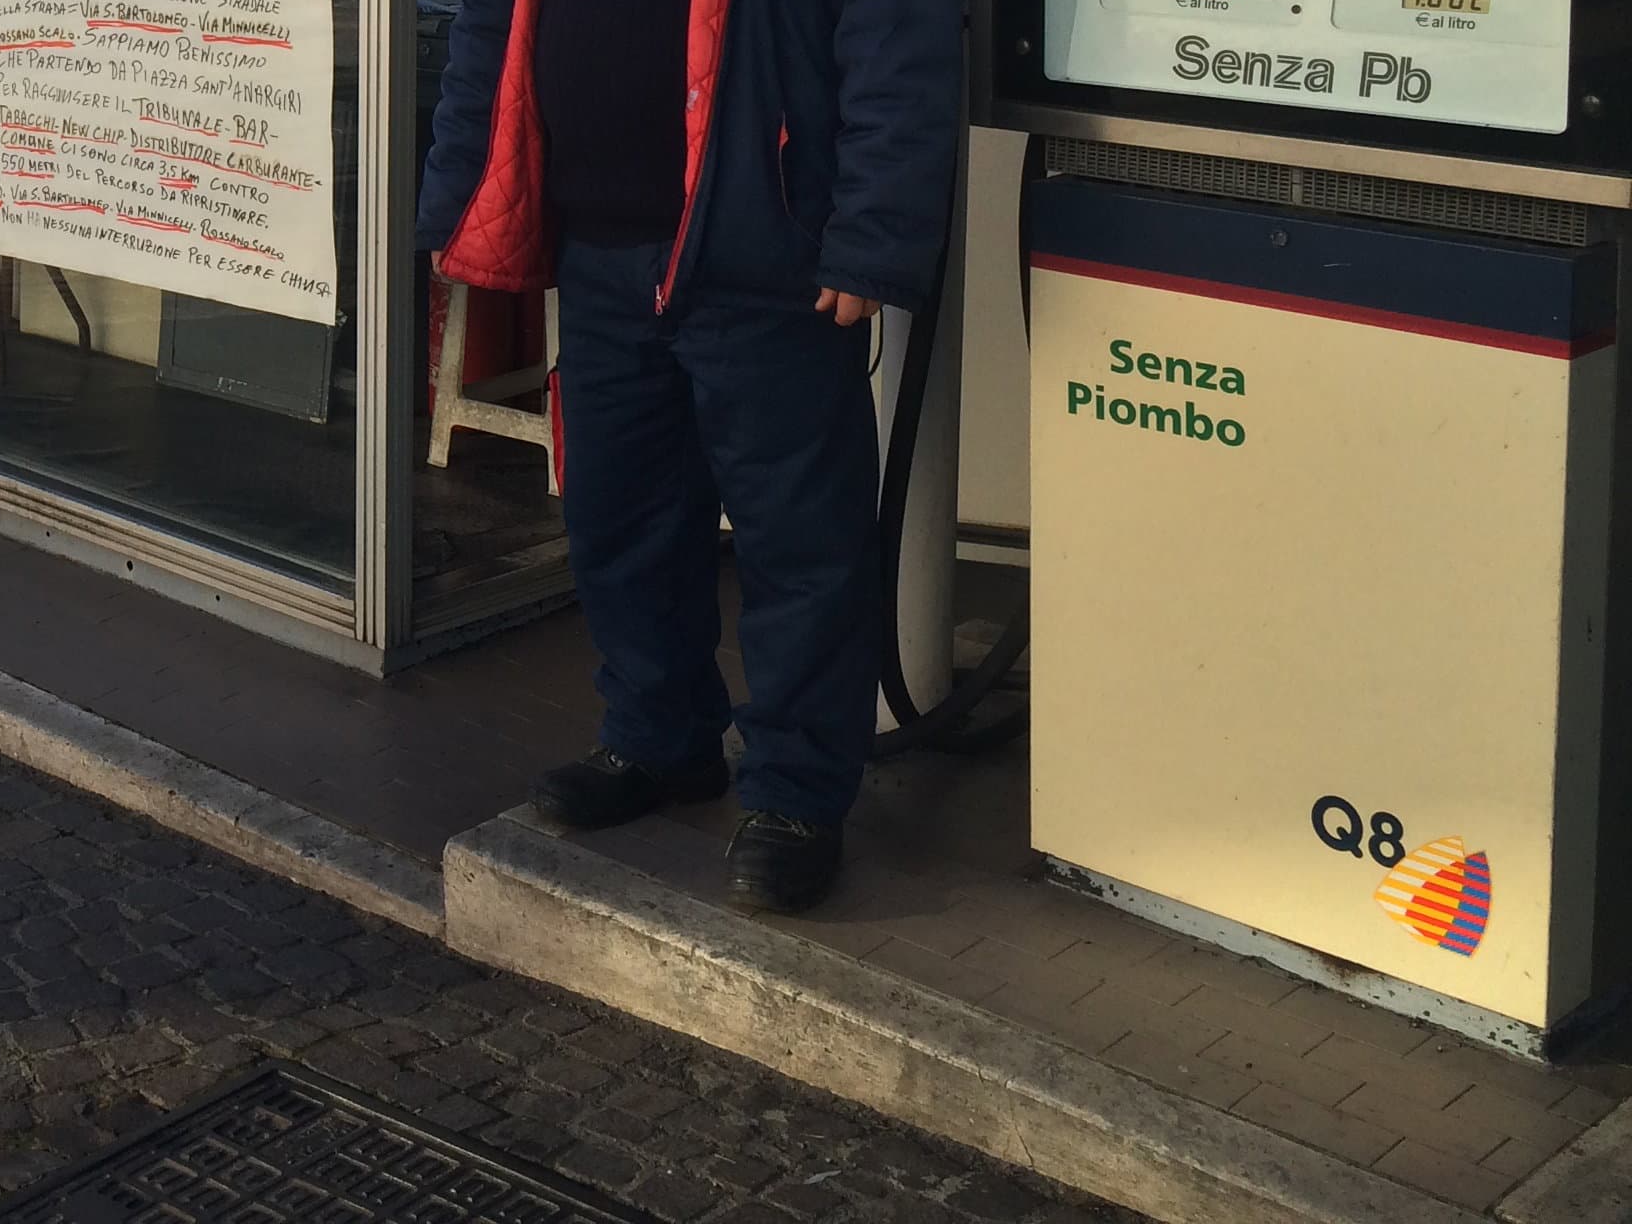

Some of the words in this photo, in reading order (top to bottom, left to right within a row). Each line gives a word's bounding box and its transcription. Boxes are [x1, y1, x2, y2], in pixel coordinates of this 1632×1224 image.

[79, 0, 99, 19] VIA
[198, 10, 219, 33] VIA
[222, 17, 291, 42] MINNICELLI
[82, 28, 169, 58] SAPPIAMO
[1431, 16, 1444, 28] al
[1448, 16, 1476, 30] litro
[26, 48, 102, 76] PARTENDO
[109, 61, 126, 81] DA
[131, 60, 188, 89] PIAZZA
[1172, 35, 1335, 94] Senza
[1359, 51, 1432, 103] Pb
[115, 95, 132, 114] IL
[0, 130, 55, 149] COMUNE
[61, 142, 76, 155] CI
[80, 145, 116, 164] SONO
[120, 153, 154, 172] CIRCA
[209, 177, 269, 204] CONTRO
[62, 116, 90, 138] NEW
[130, 128, 222, 167] DISTRIBUTORE
[1, 152, 24, 170] 550
[29, 159, 60, 174] METRI
[67, 164, 90, 181] DEL
[95, 168, 154, 196] PERCORSO
[160, 186, 176, 201] DA
[1, 207, 23, 224] NON
[43, 216, 92, 239] NESSUNA
[95, 227, 181, 260] INTERRUZIONE
[188, 247, 212, 269] PER
[217, 257, 275, 280] ESSERE
[10, 184, 27, 200] VIA
[116, 200, 134, 215] VIA
[200, 218, 249, 248] ROSSANO
[252, 239, 286, 261] SCALO
[1110, 339, 1246, 396] Senza
[1068, 381, 1246, 447] Piombo
[1312, 795, 1406, 868] Q8
